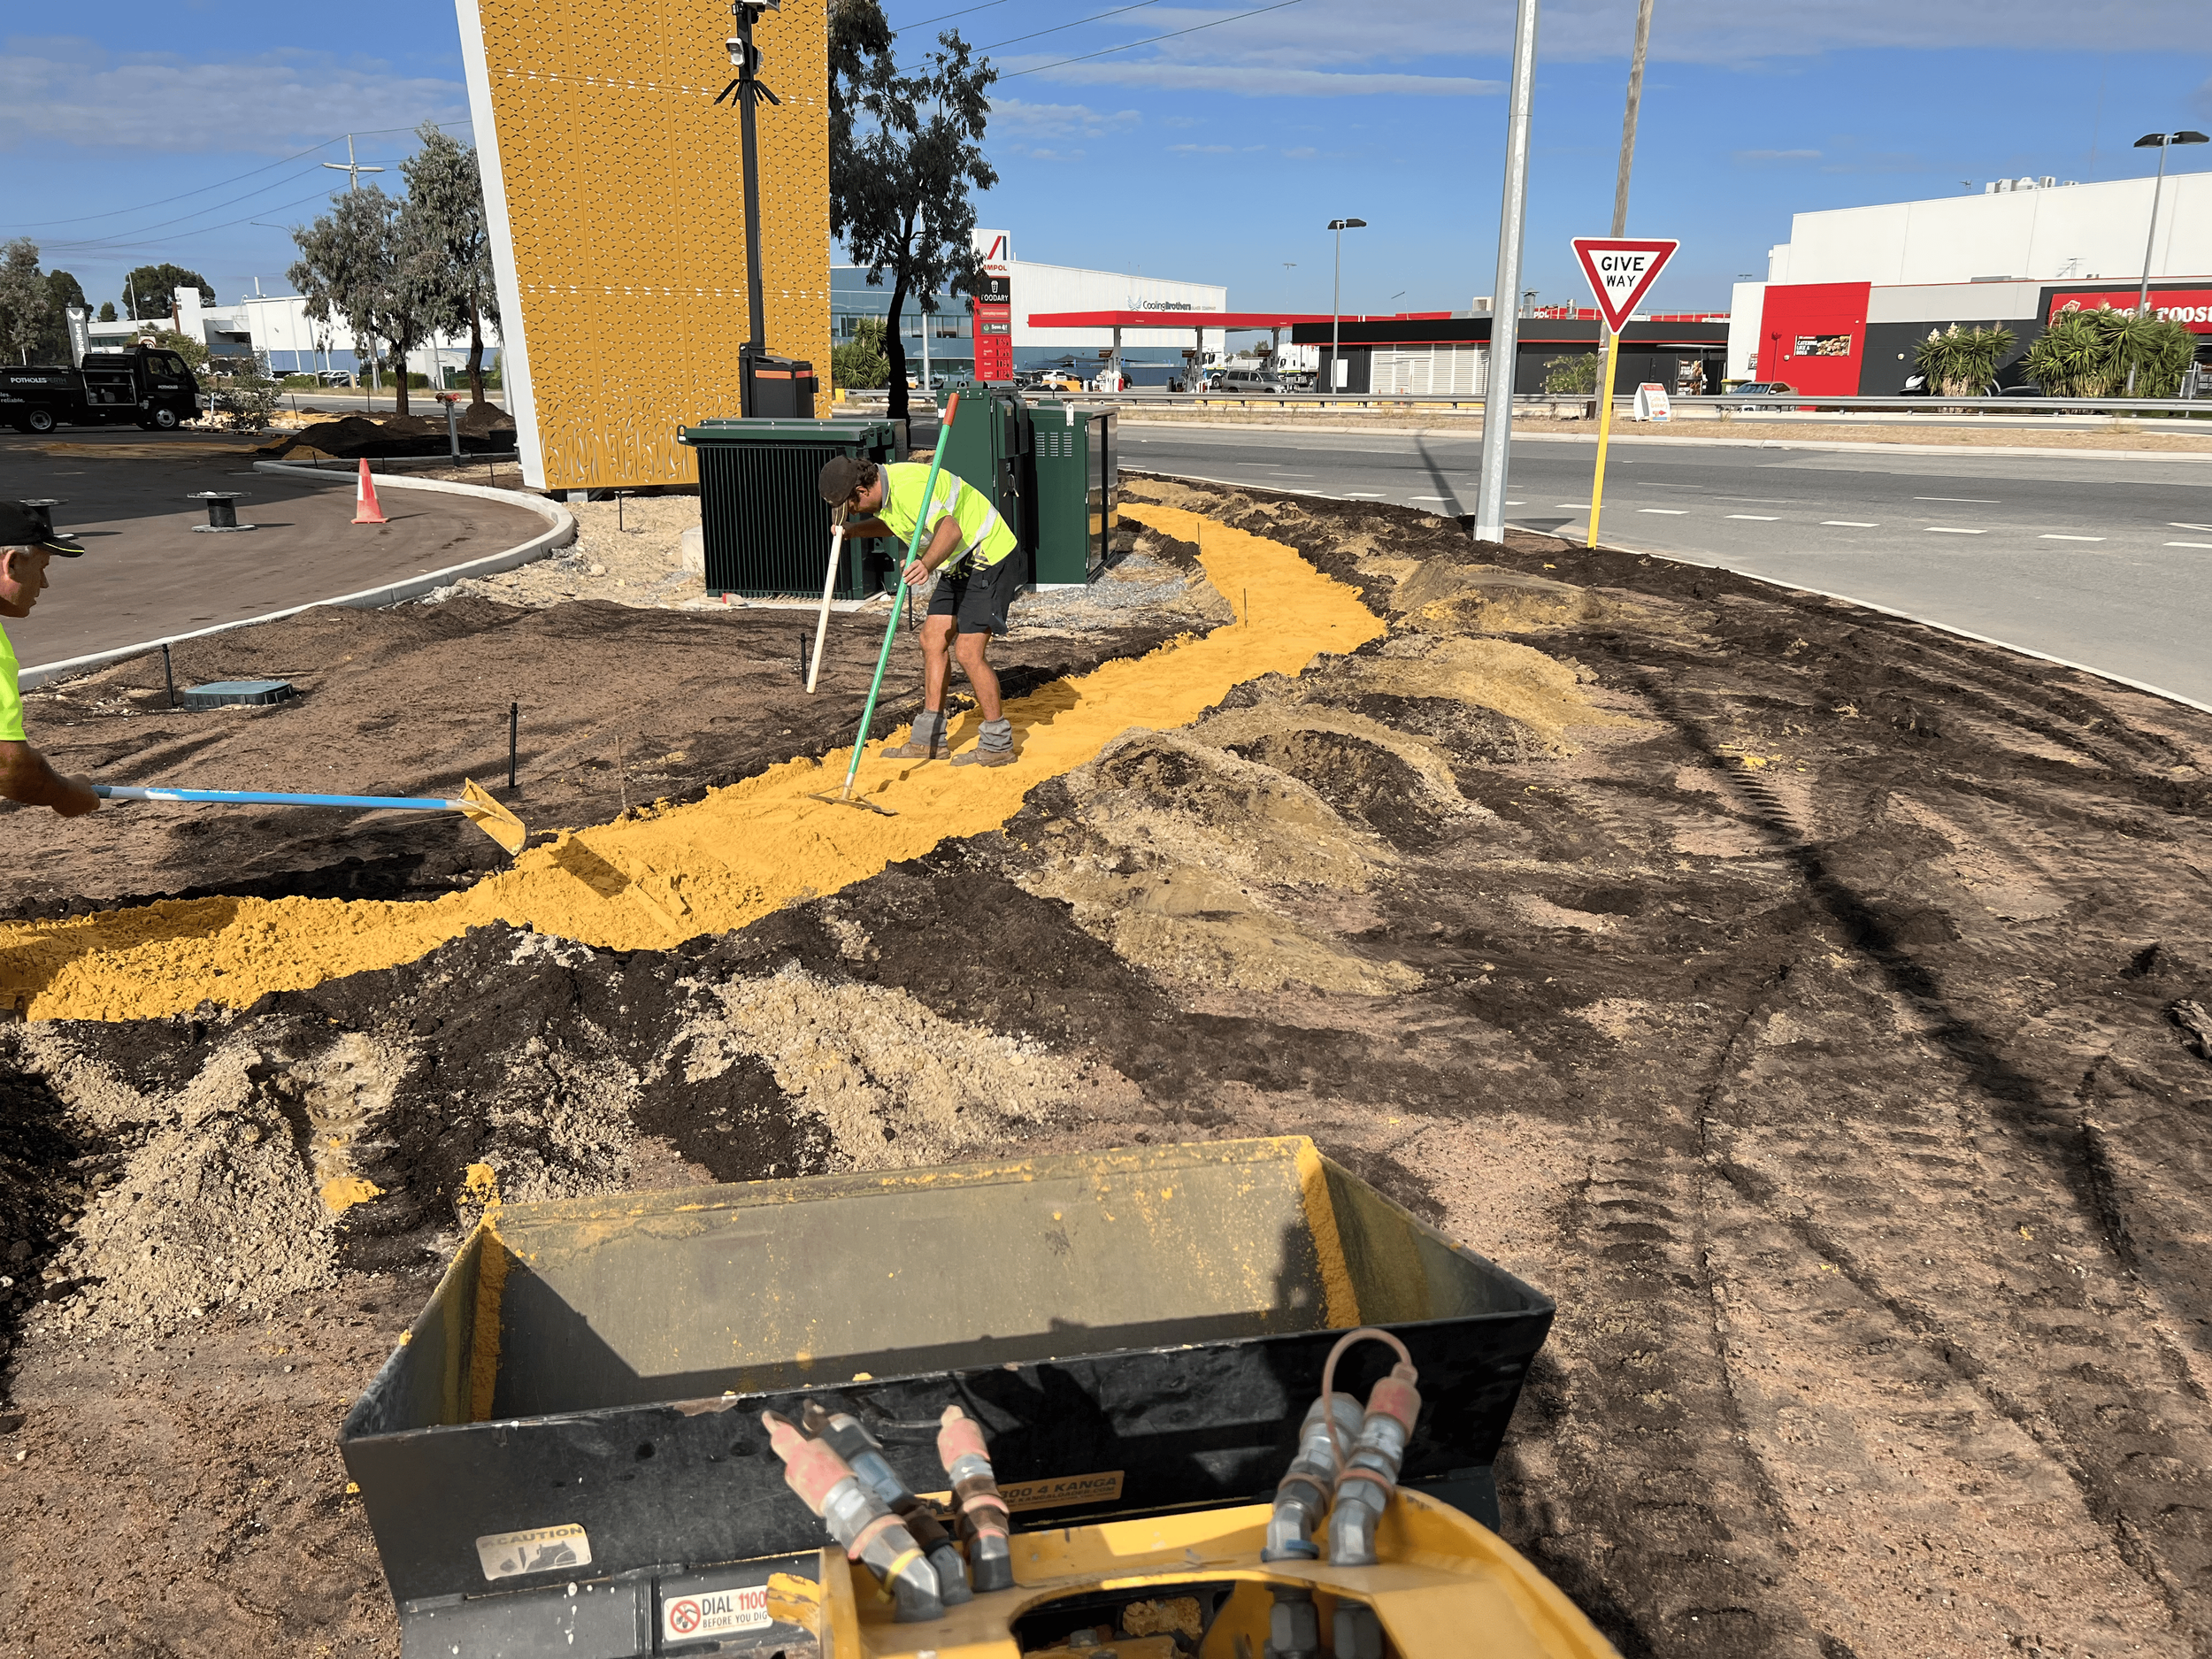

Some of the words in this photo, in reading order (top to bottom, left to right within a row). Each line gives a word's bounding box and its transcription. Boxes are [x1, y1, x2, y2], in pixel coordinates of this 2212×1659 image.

[1601, 257, 1645, 271] GIVE
[1607, 275, 1636, 287] WAY
[1054, 1477, 1117, 1493] KANGA
[496, 1526, 583, 1546] CAUTION
[702, 1595, 733, 1616] DIAL
[738, 1591, 767, 1610] 1100
[703, 1615, 733, 1628] BEFORE
[735, 1613, 751, 1624] YOU
[754, 1611, 768, 1621] DIG
